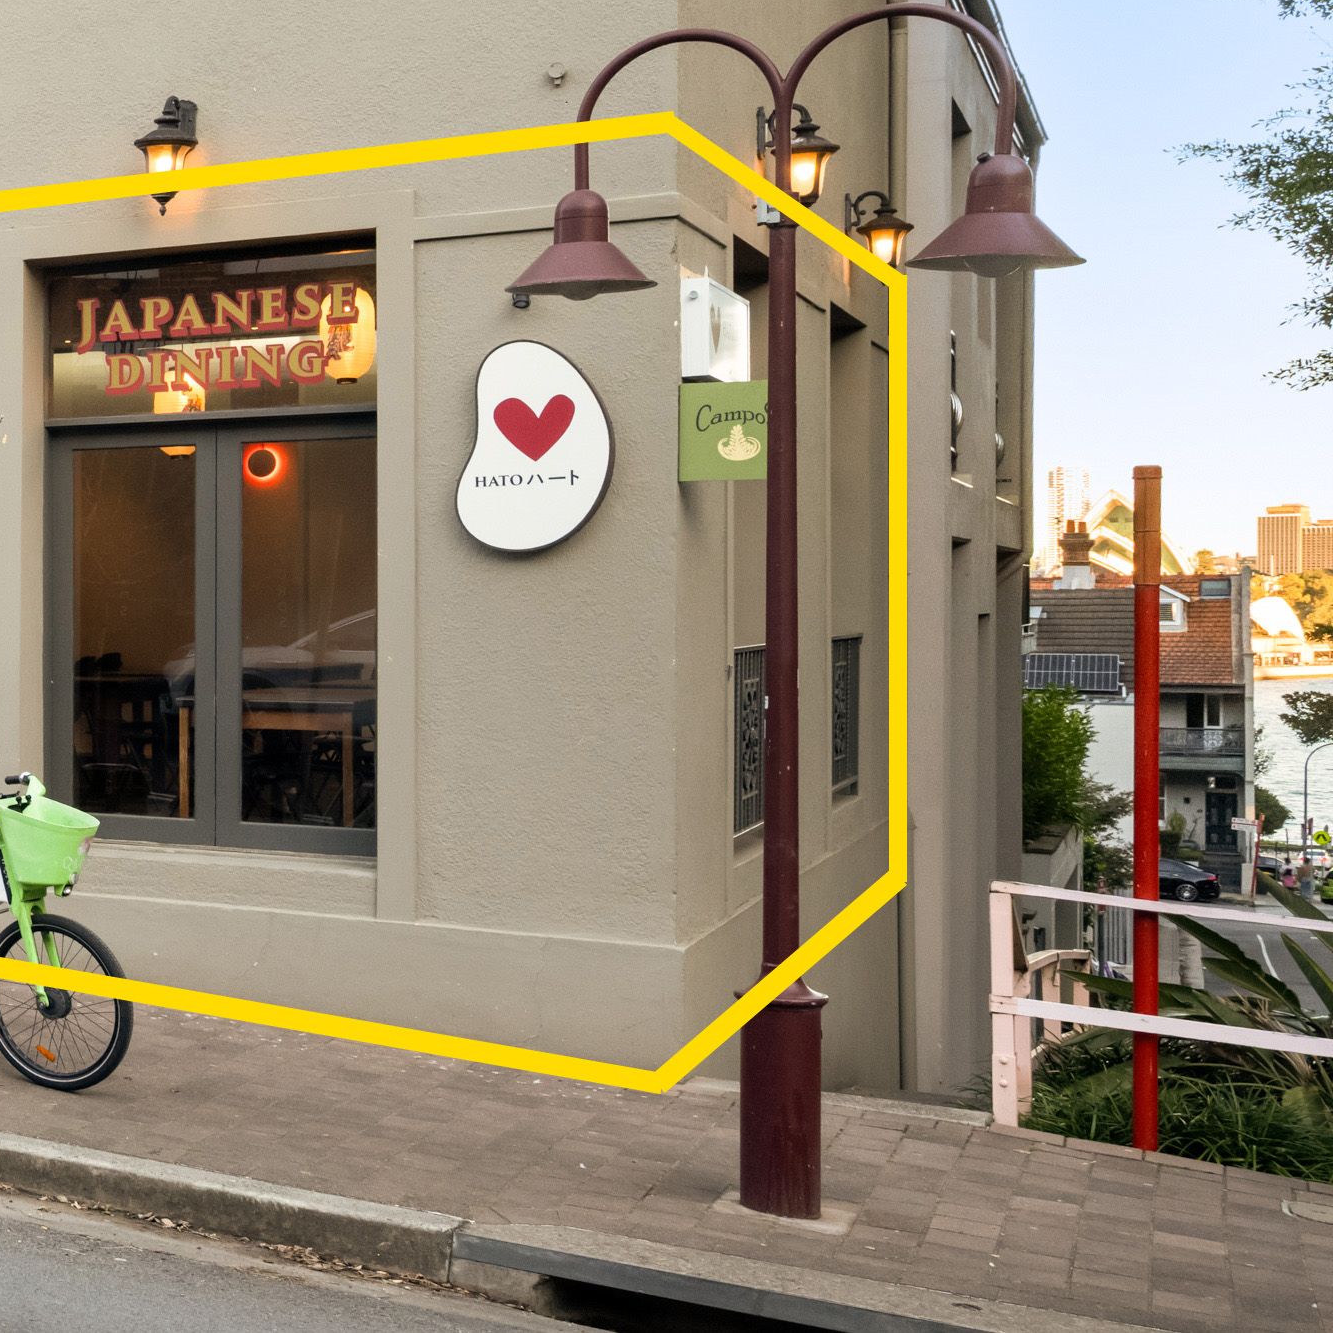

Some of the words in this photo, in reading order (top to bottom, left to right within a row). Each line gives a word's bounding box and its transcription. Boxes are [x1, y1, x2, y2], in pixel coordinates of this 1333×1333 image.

[77, 282, 359, 354] JAPANESE
[106, 340, 331, 396] DINING
[475, 474, 523, 487] HATO
[527, 470, 579, 486] ハート
